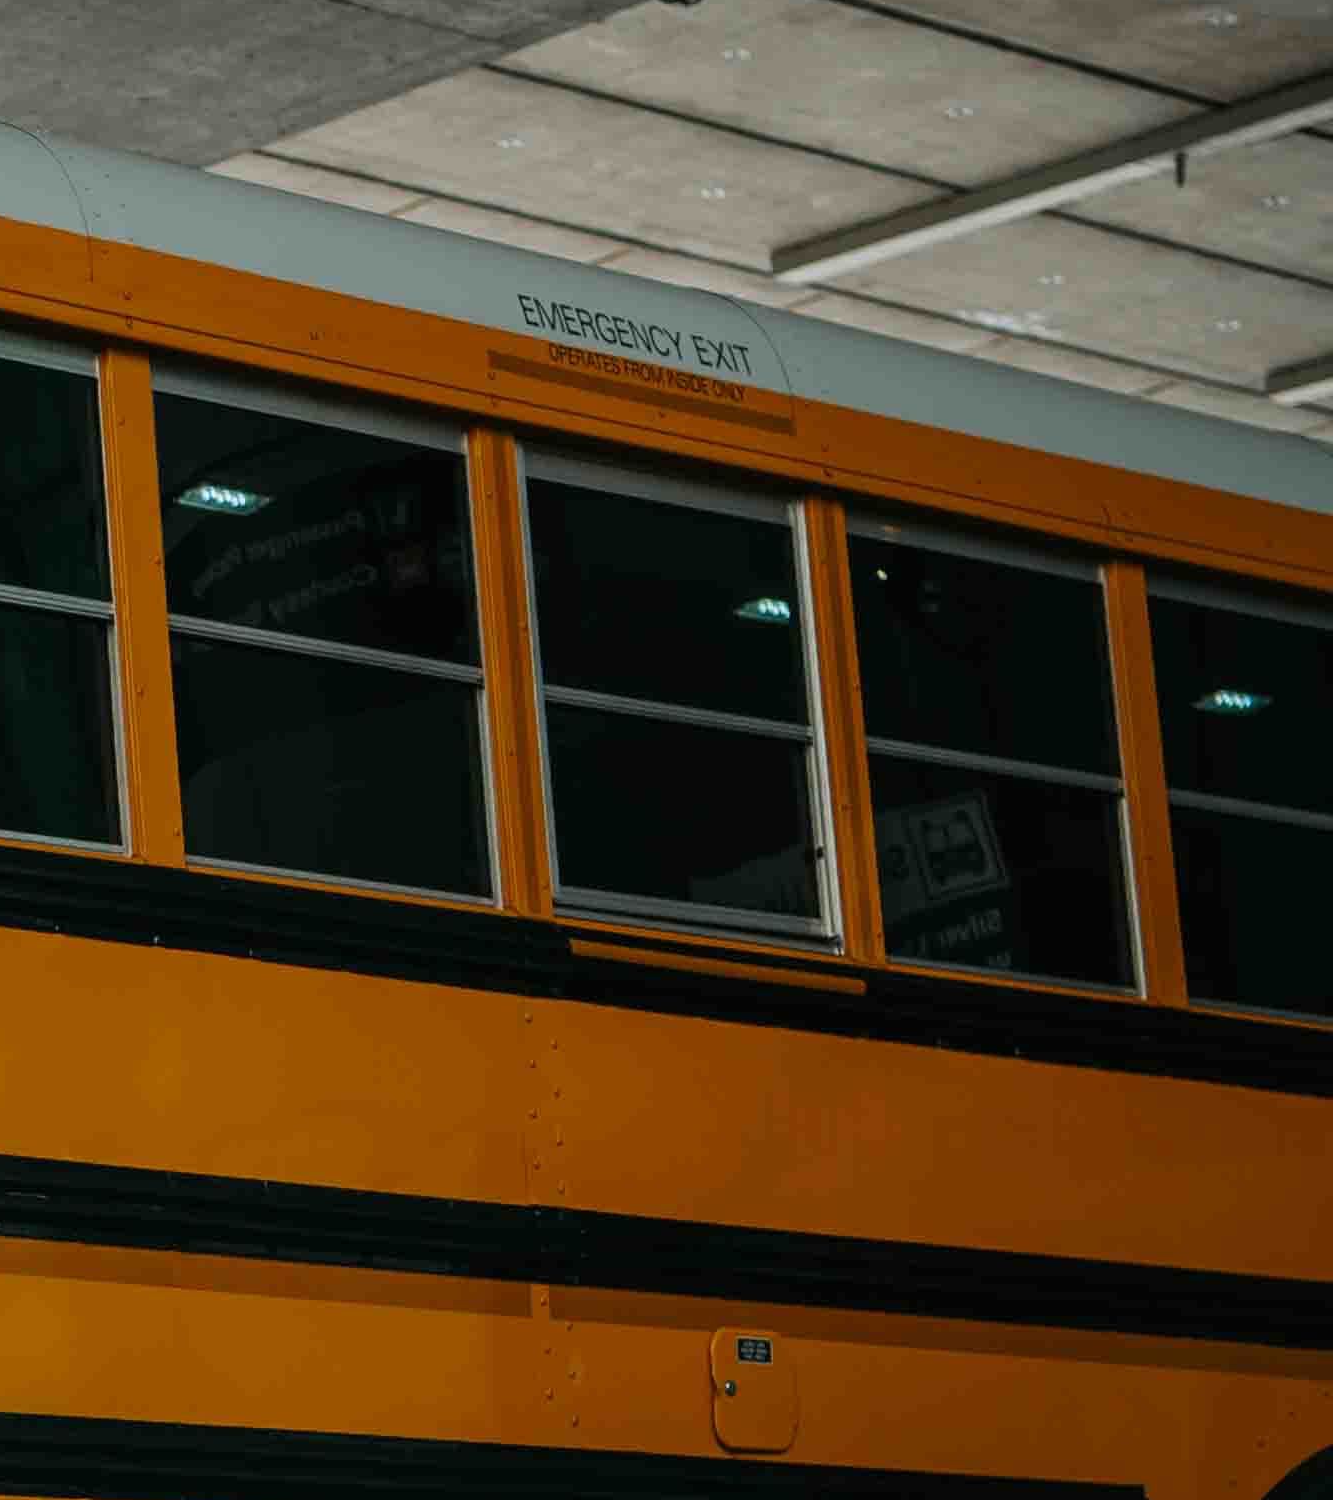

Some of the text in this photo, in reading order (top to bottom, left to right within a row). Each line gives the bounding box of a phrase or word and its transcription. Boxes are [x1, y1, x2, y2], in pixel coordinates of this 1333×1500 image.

[517, 292, 753, 377] EMERGENCY EXIT
[548, 342, 748, 402] OPERATES FROM INSIDE ONLY
